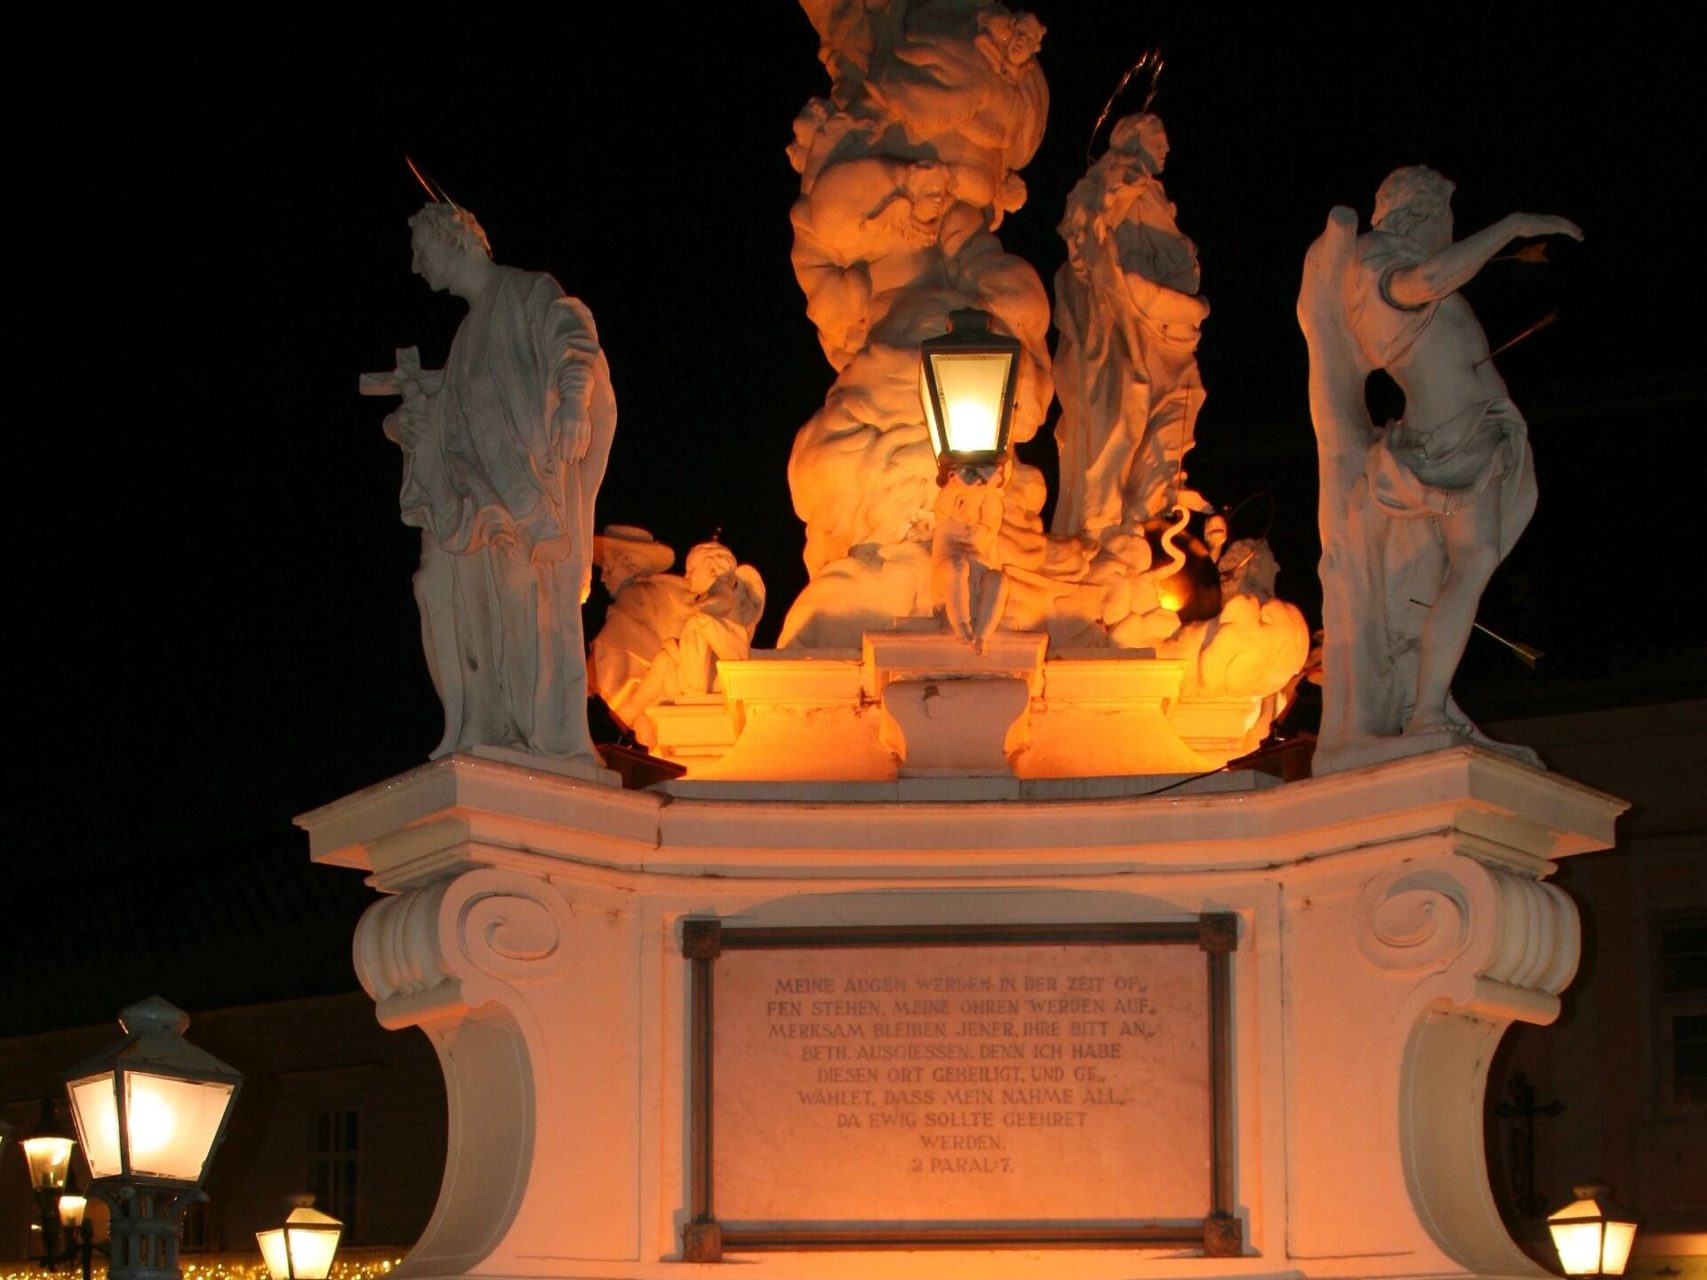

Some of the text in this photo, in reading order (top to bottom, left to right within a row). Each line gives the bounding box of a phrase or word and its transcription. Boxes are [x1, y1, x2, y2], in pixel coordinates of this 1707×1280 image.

[775, 978, 834, 994] MEINE
[843, 977, 906, 993] AUGEN
[916, 977, 991, 992] WERDEN
[1000, 976, 1016, 992] IN
[1025, 976, 1057, 992] DER
[1067, 976, 1105, 992] ZEIT
[767, 1001, 801, 1017] FEN
[892, 999, 950, 1015] MEINE
[960, 999, 1018, 1015] OHREN
[1025, 999, 1105, 1015] WERDEN
[768, 1023, 865, 1039] MERKSAM
[873, 1022, 946, 1038] BLEIBEN
[1023, 1021, 1060, 1037] IHRE
[1071, 1021, 1109, 1037] BITT
[980, 1043, 1024, 1060] DENN
[1034, 1043, 1062, 1060] ICH
[1071, 1042, 1122, 1059] HABE
[818, 1067, 879, 1083] DIESEN
[887, 1067, 925, 1083] ORT
[1031, 1066, 1064, 1082] UND
[885, 1089, 934, 1105] DASS
[944, 1088, 994, 1105] MEIN
[1002, 1088, 1073, 1105] NAHME
[836, 1111, 1087, 1128] DA EWIG SOLLTE GEEHRET
[912, 1158, 923, 1173] 2
